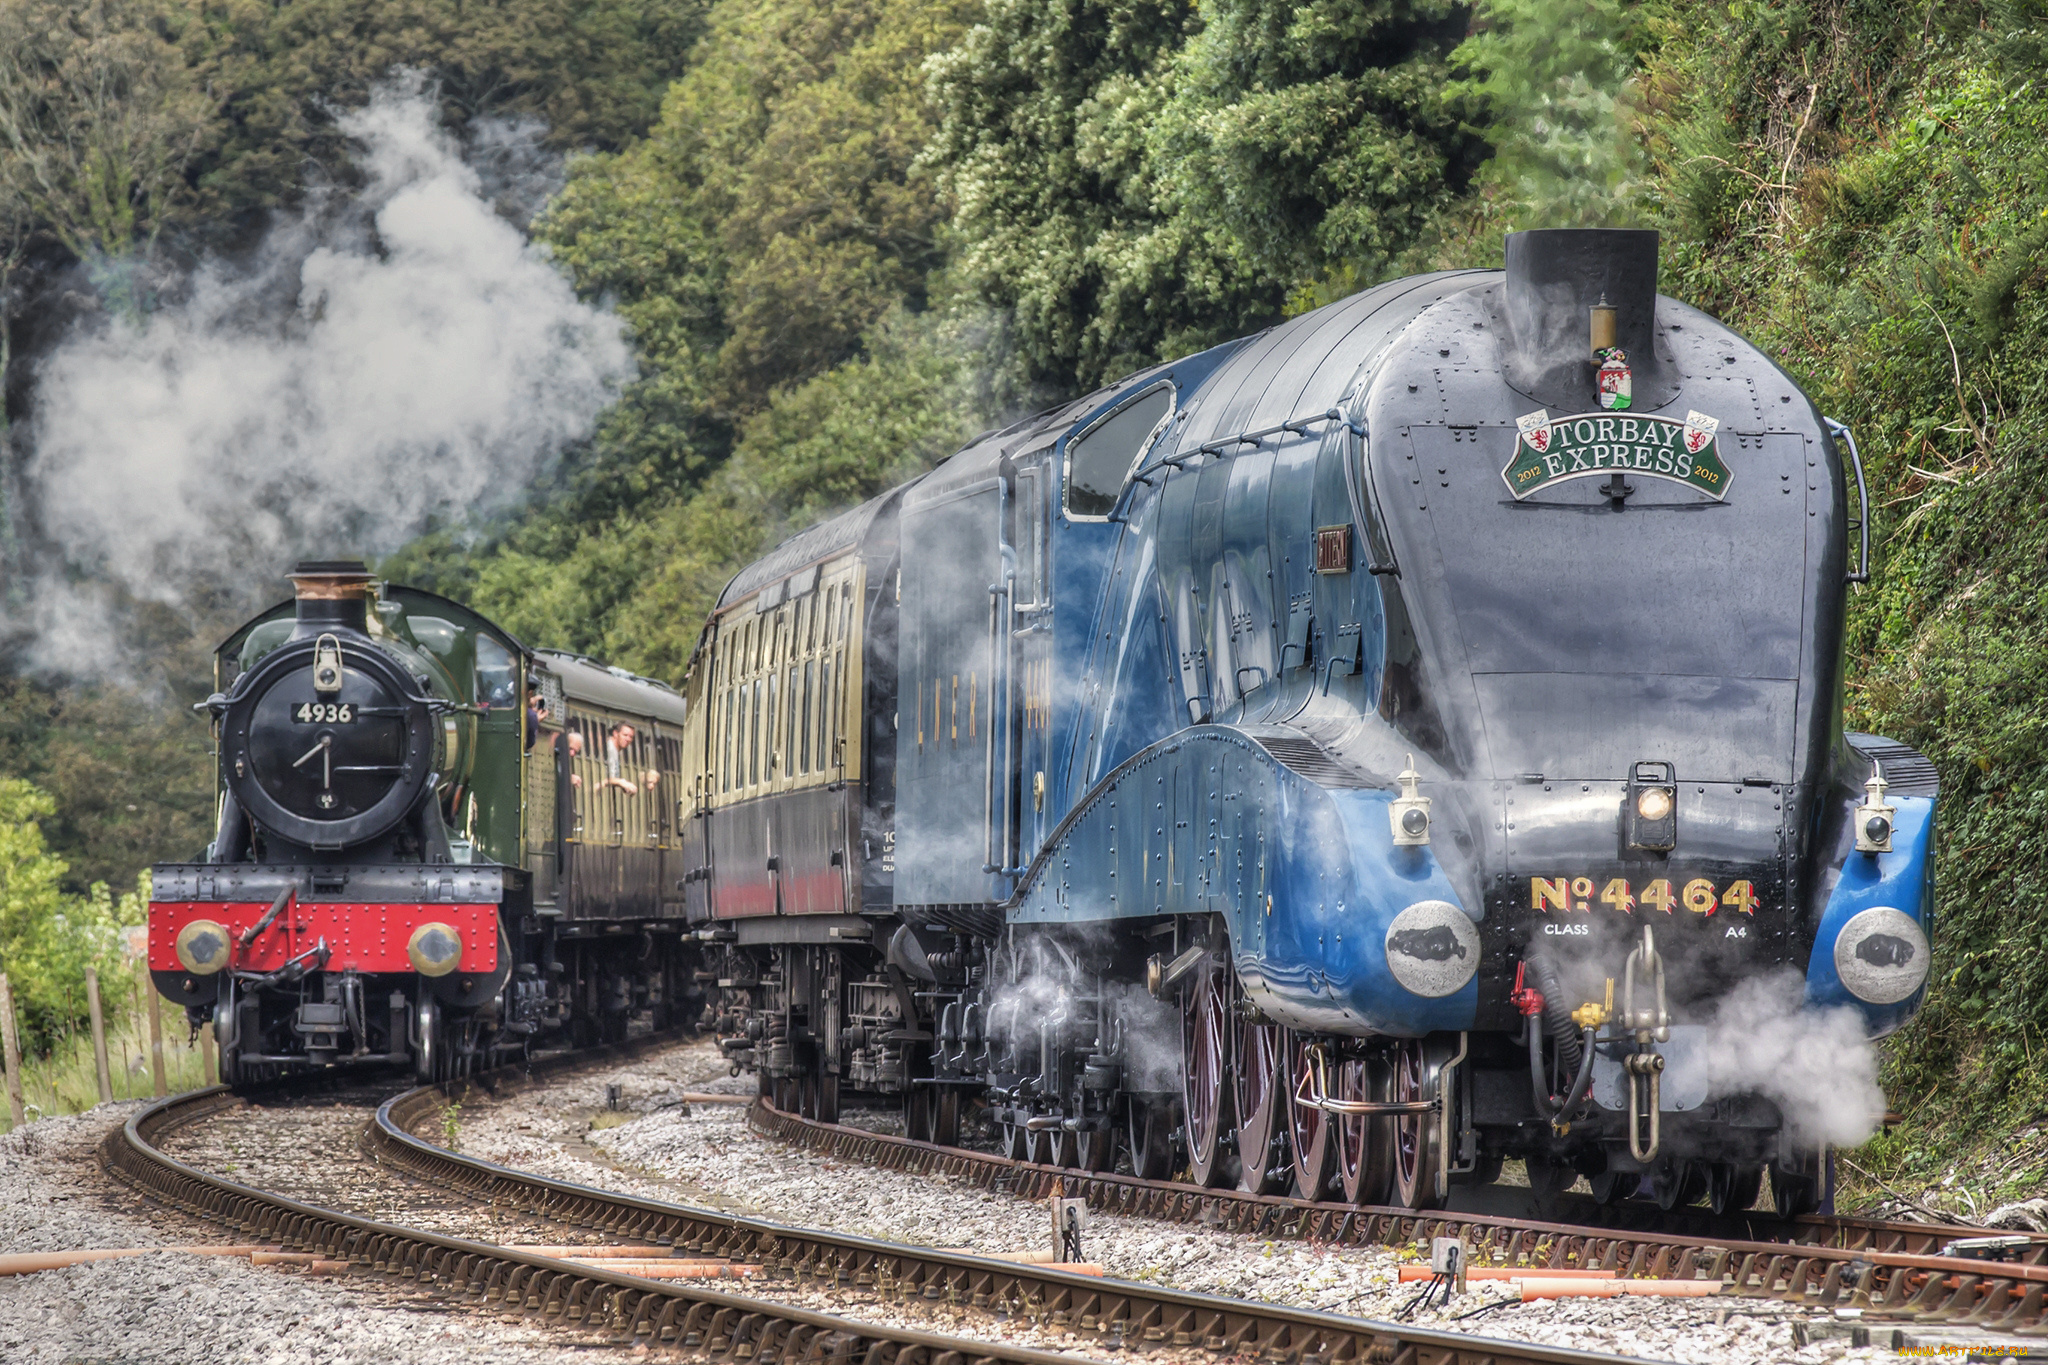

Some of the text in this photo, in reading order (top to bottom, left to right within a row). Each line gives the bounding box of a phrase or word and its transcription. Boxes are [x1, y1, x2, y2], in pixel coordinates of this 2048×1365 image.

[1552, 418, 1682, 448] TORBAY
[1542, 444, 1694, 480] EXPRESS
[1517, 465, 1542, 484] 2012
[1693, 465, 1719, 484] 2012
[296, 702, 352, 723] 4936
[1600, 878, 1760, 917] 4464
[1544, 923, 1589, 936] CLASS
[1725, 926, 1747, 939] A4
